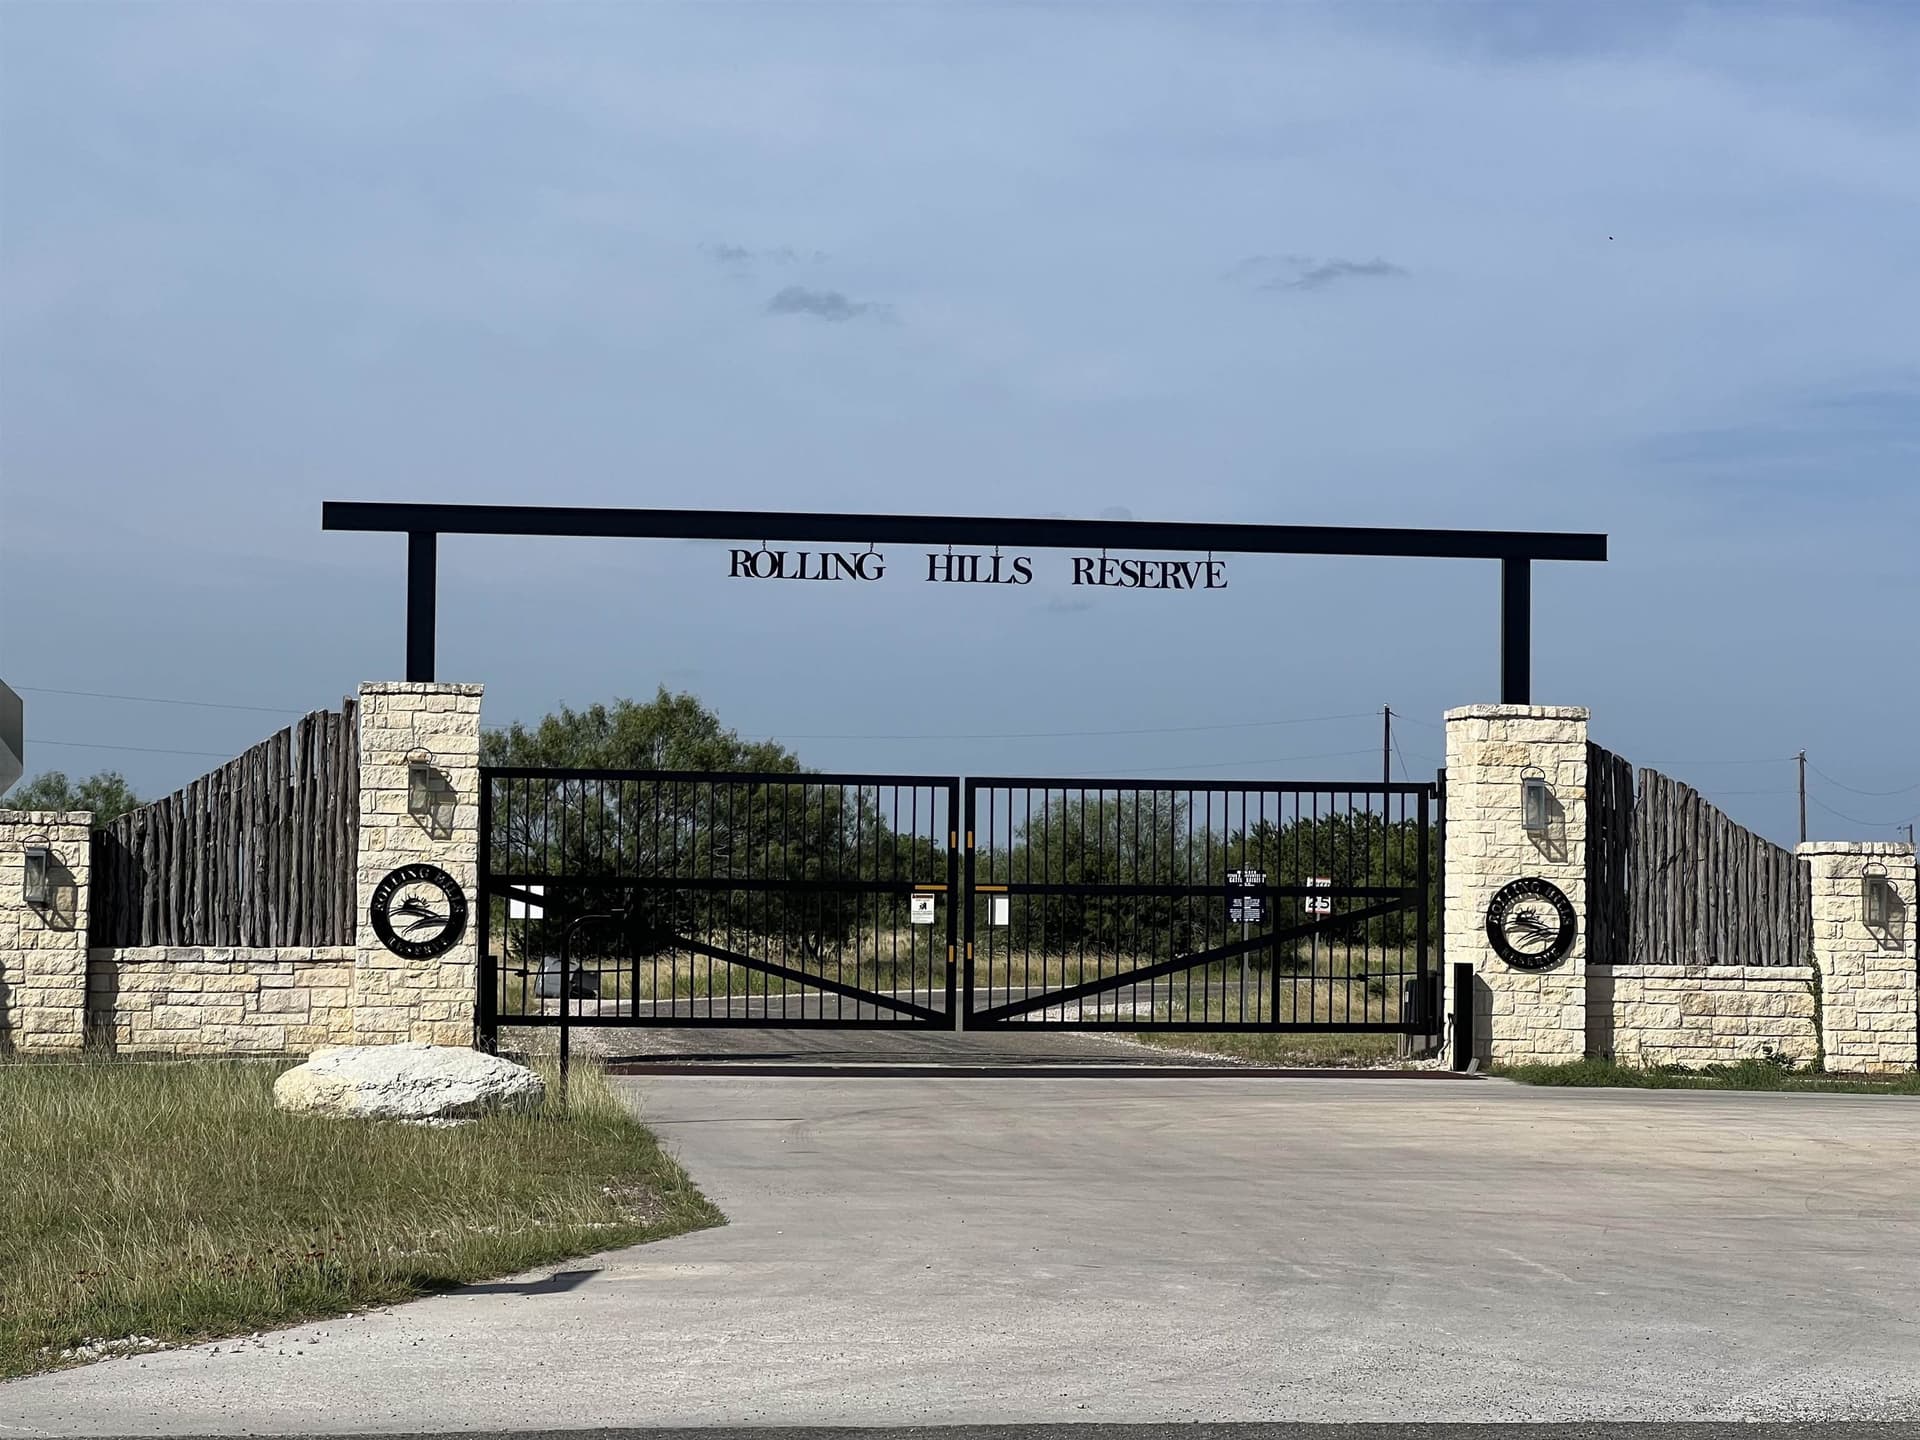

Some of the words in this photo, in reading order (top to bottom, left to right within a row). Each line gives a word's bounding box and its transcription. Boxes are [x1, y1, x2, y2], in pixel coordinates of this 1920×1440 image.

[728, 549, 885, 581] ROLLING
[926, 553, 1033, 586] HILLS
[1072, 557, 1228, 590] RESERVE
[375, 867, 430, 912] ROLLING
[1488, 880, 1541, 926] ROLLING
[1544, 886, 1572, 926] HILLS
[1501, 947, 1561, 967] RESERVE
